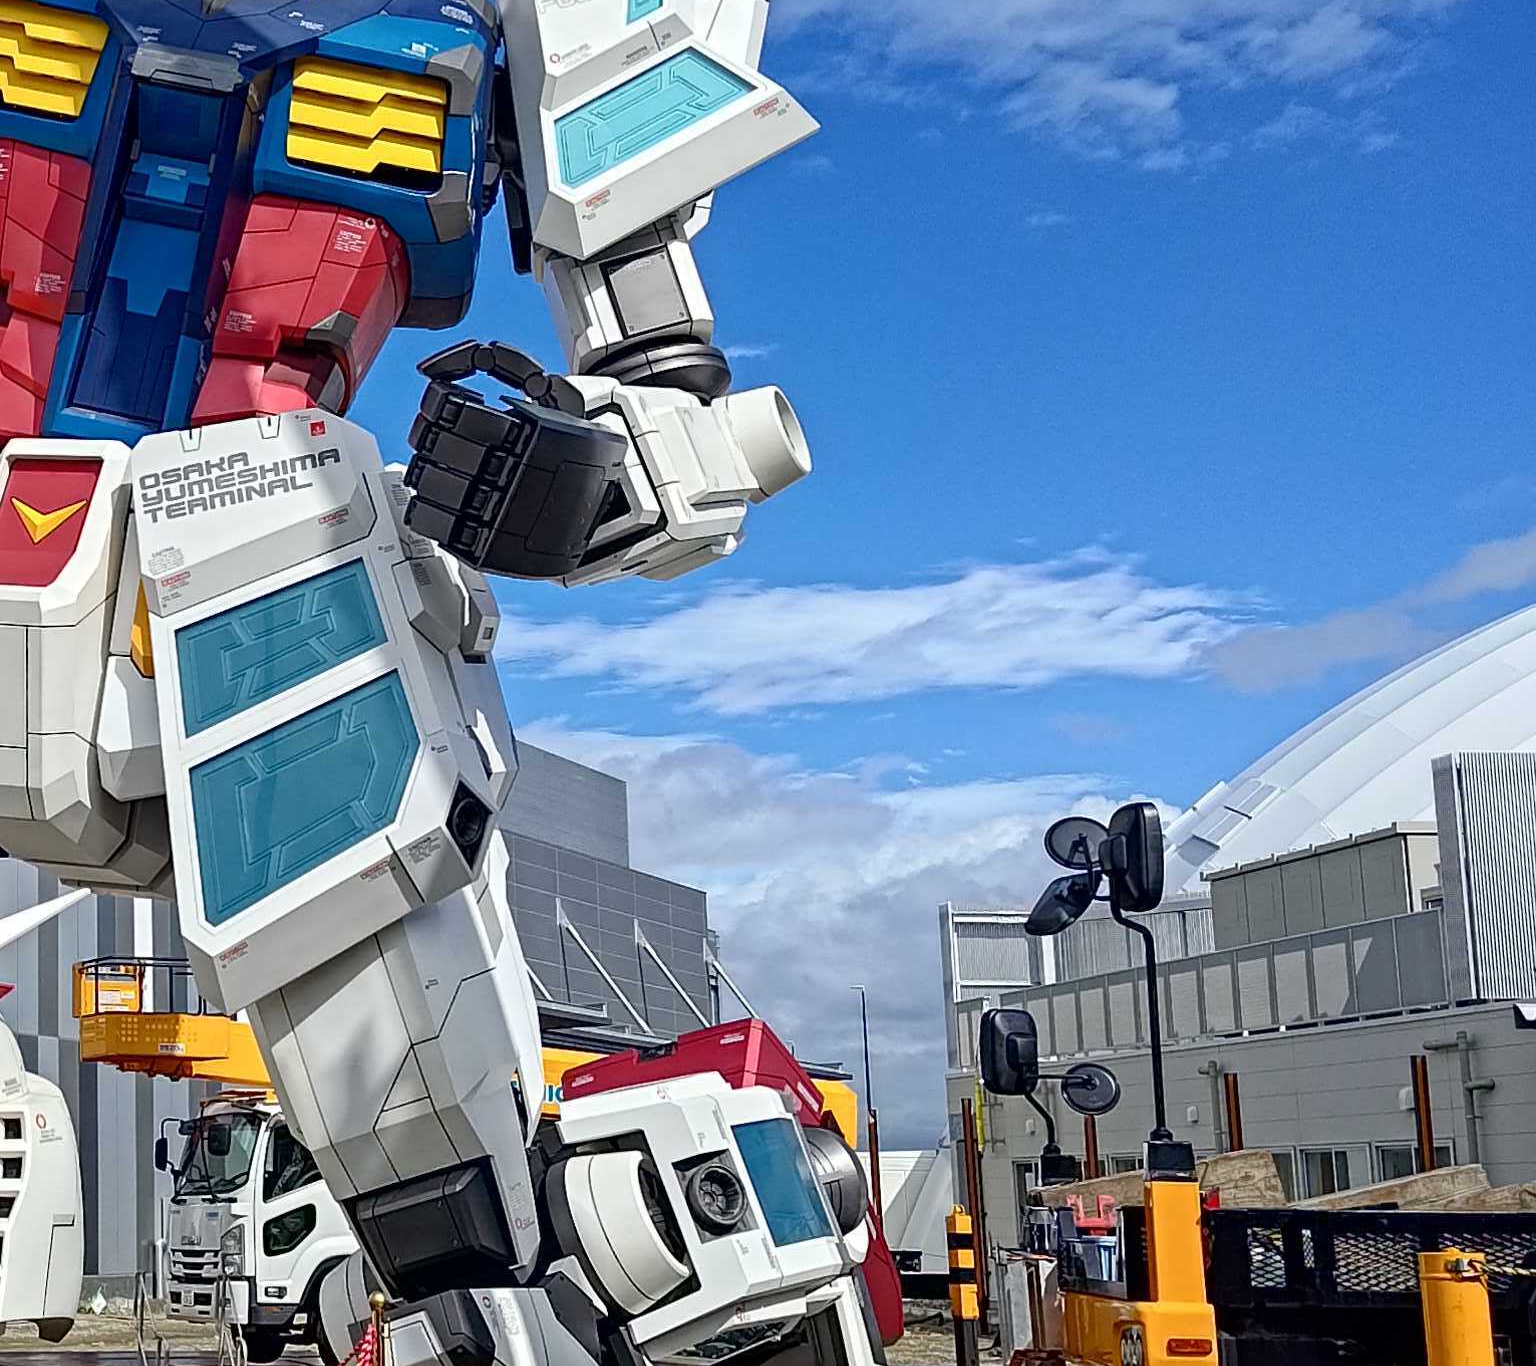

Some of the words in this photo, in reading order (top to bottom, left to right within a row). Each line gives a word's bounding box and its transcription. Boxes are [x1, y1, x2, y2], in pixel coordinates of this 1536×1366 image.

[139, 451, 249, 491] OSAKA
[141, 448, 341, 507] YUMESHIMA
[144, 476, 314, 523] TERMINAL
